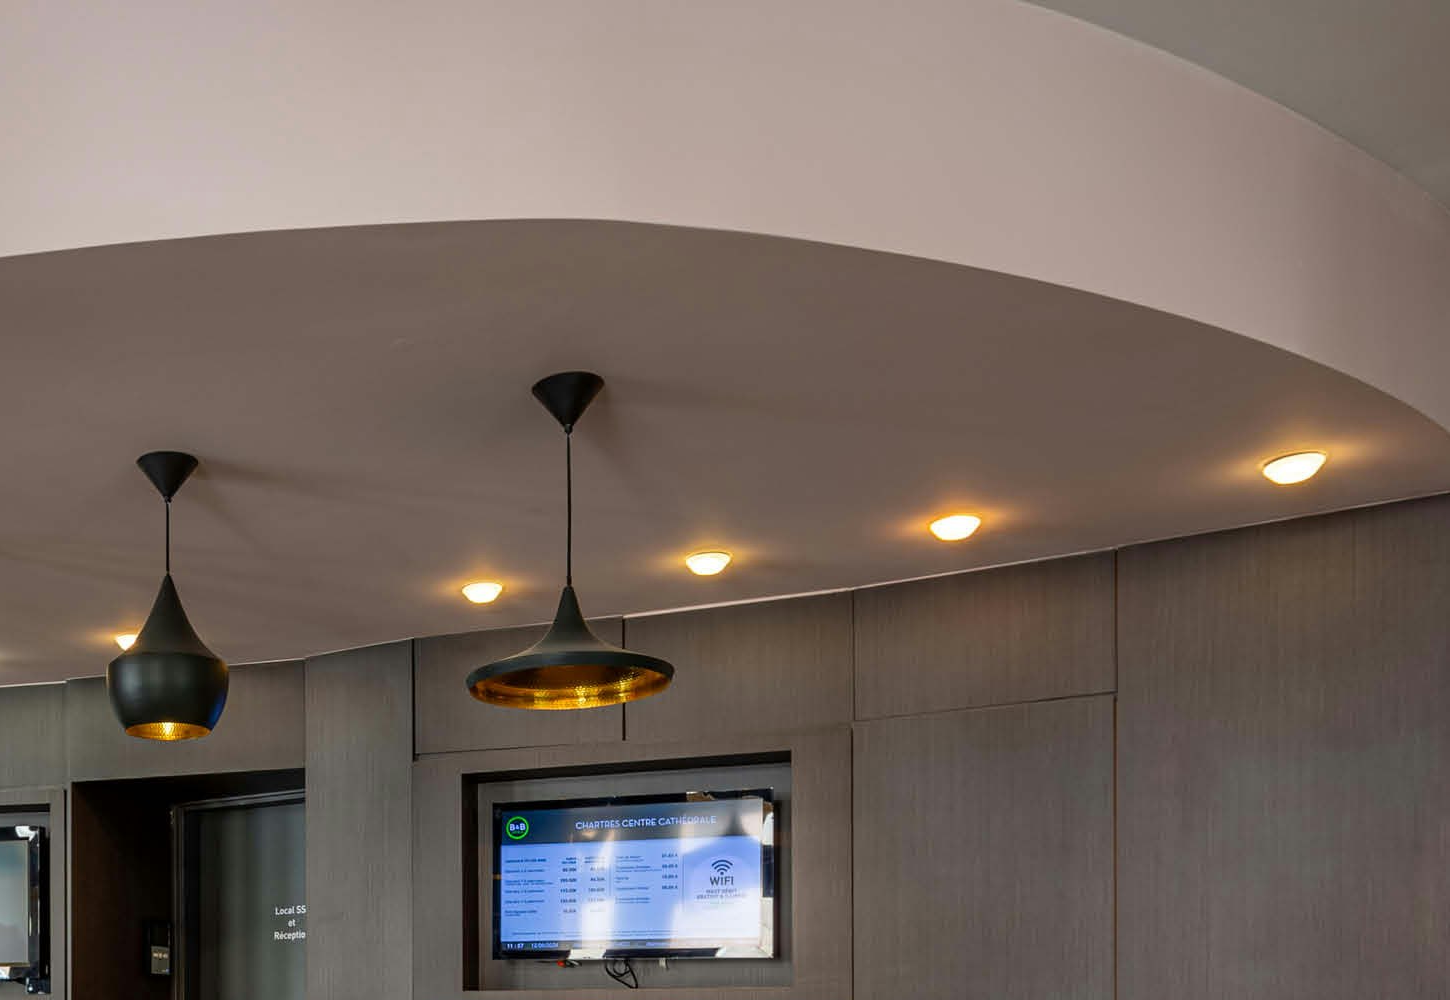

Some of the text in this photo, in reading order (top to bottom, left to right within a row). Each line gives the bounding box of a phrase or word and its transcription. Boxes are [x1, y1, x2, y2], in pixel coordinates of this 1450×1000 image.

[575, 819, 621, 831] CHARTRES
[621, 817, 658, 829] CENTRE
[709, 876, 735, 887] WIFI
[275, 906, 295, 916] Local
[288, 919, 296, 927] et
